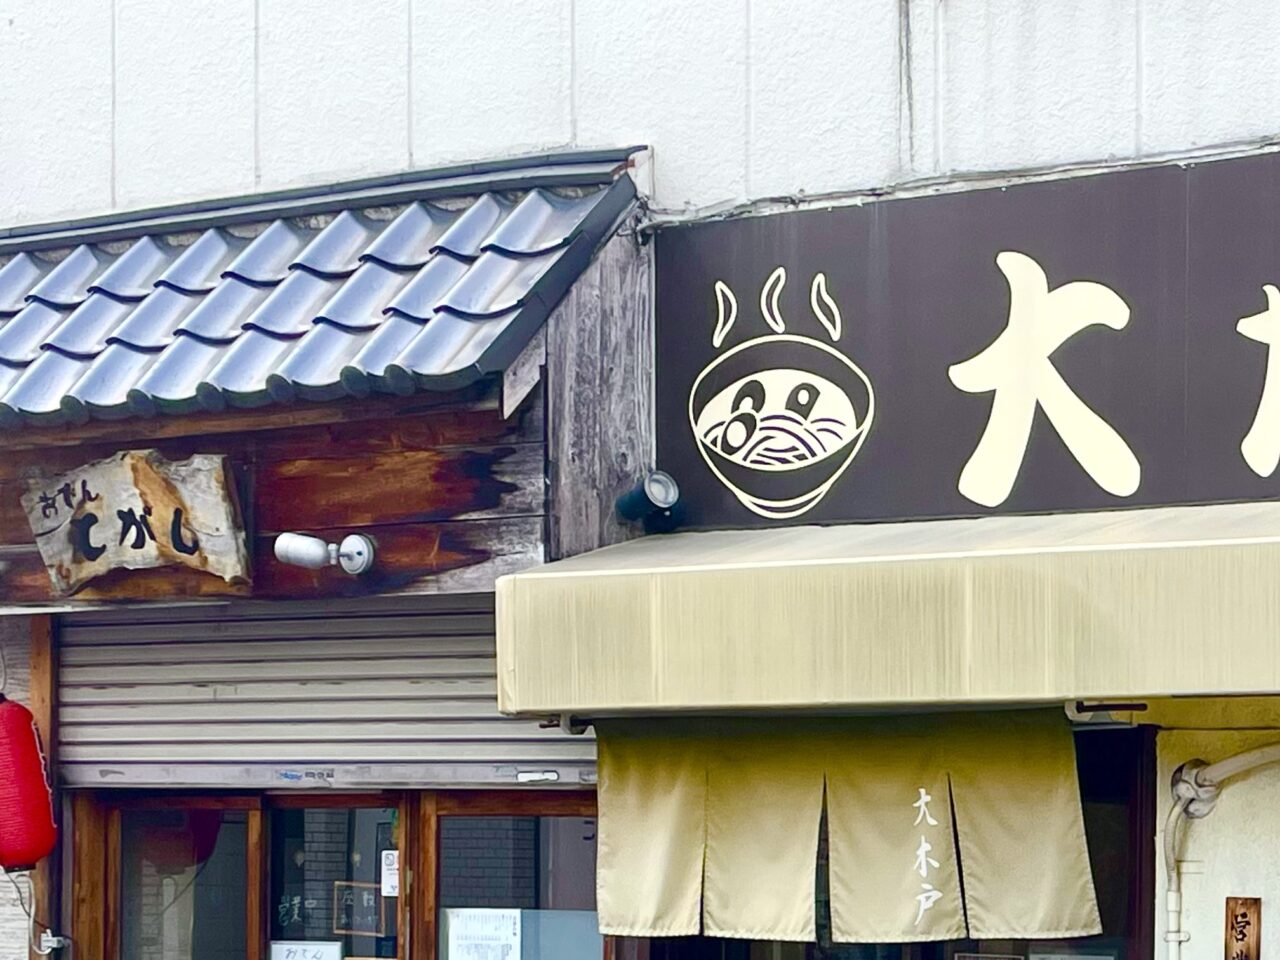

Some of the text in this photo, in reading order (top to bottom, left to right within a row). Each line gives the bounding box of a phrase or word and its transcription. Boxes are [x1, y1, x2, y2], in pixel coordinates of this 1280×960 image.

[38, 479, 100, 519] おでん
[69, 507, 199, 562] とがし
[911, 787, 944, 926] 大木戸
